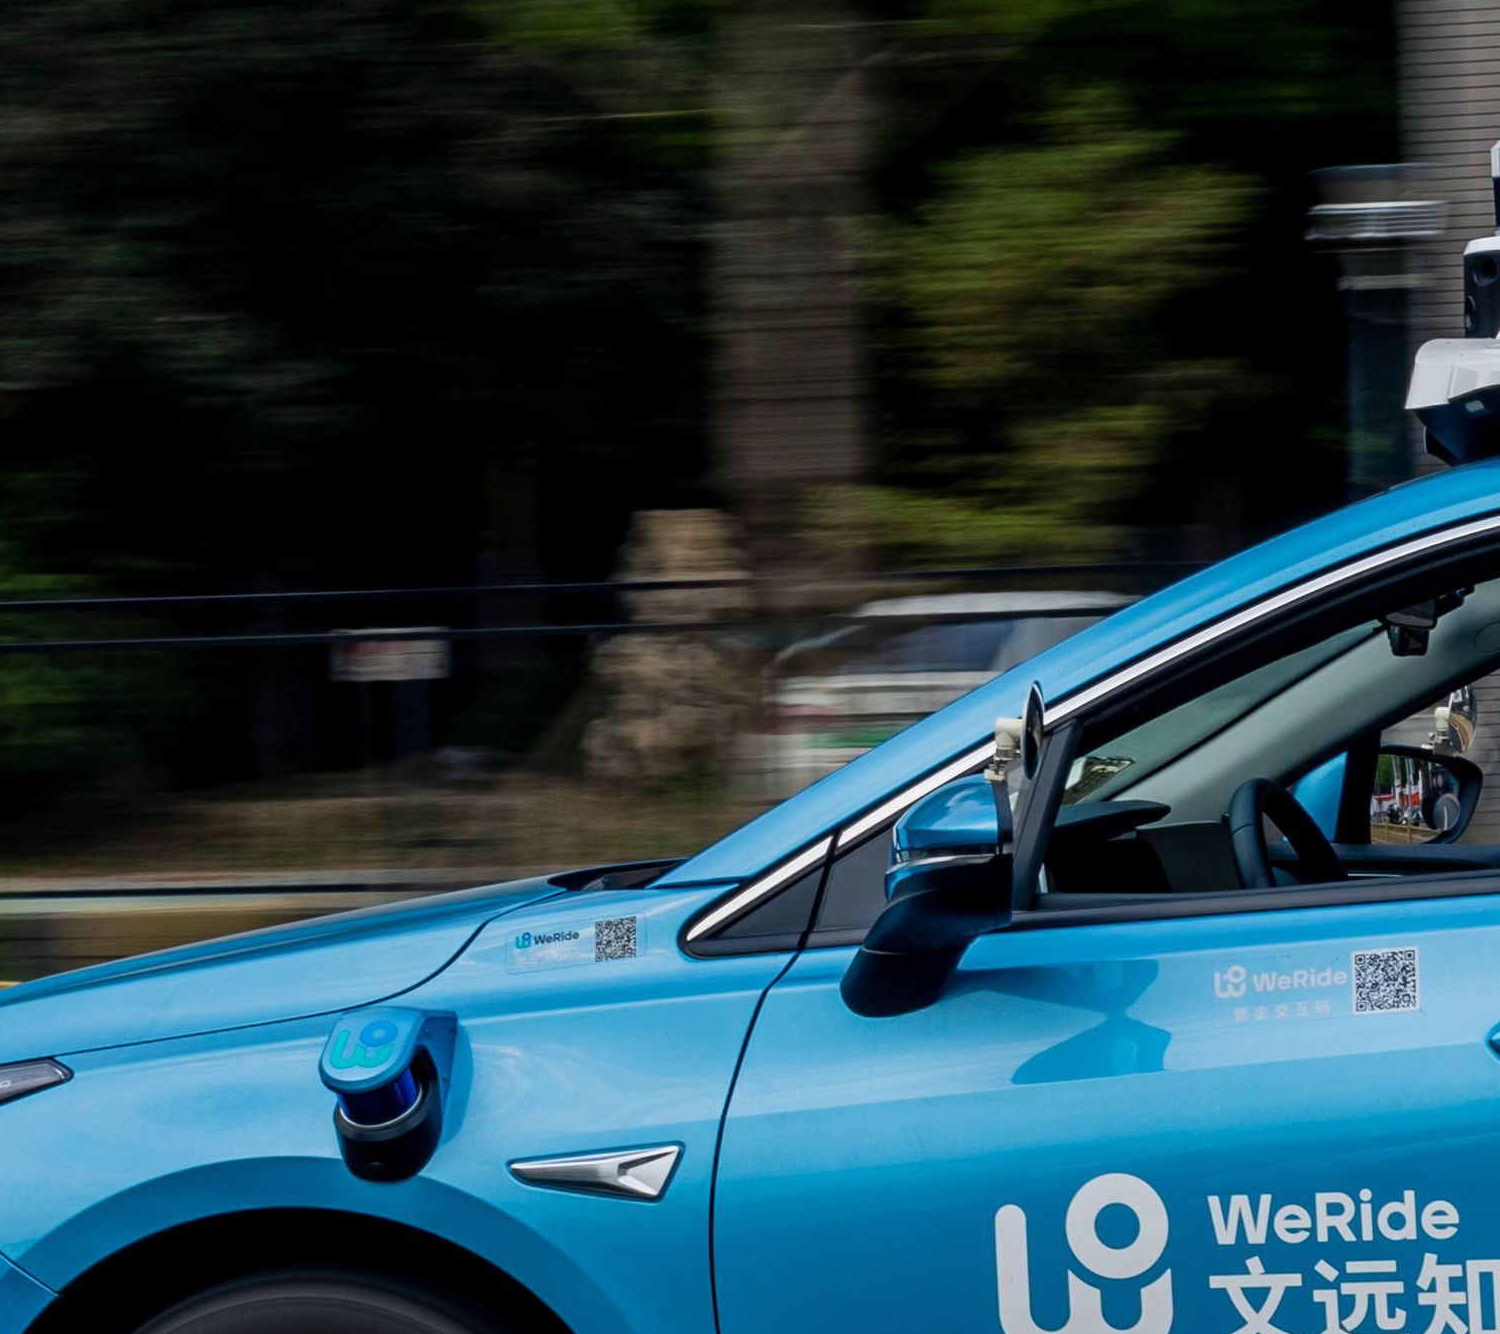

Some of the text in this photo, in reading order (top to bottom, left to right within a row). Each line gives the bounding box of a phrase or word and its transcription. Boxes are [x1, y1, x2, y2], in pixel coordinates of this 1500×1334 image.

[533, 930, 579, 945] WeRide
[1251, 968, 1348, 992] WeRide
[1208, 1189, 1461, 1246] WeRide
